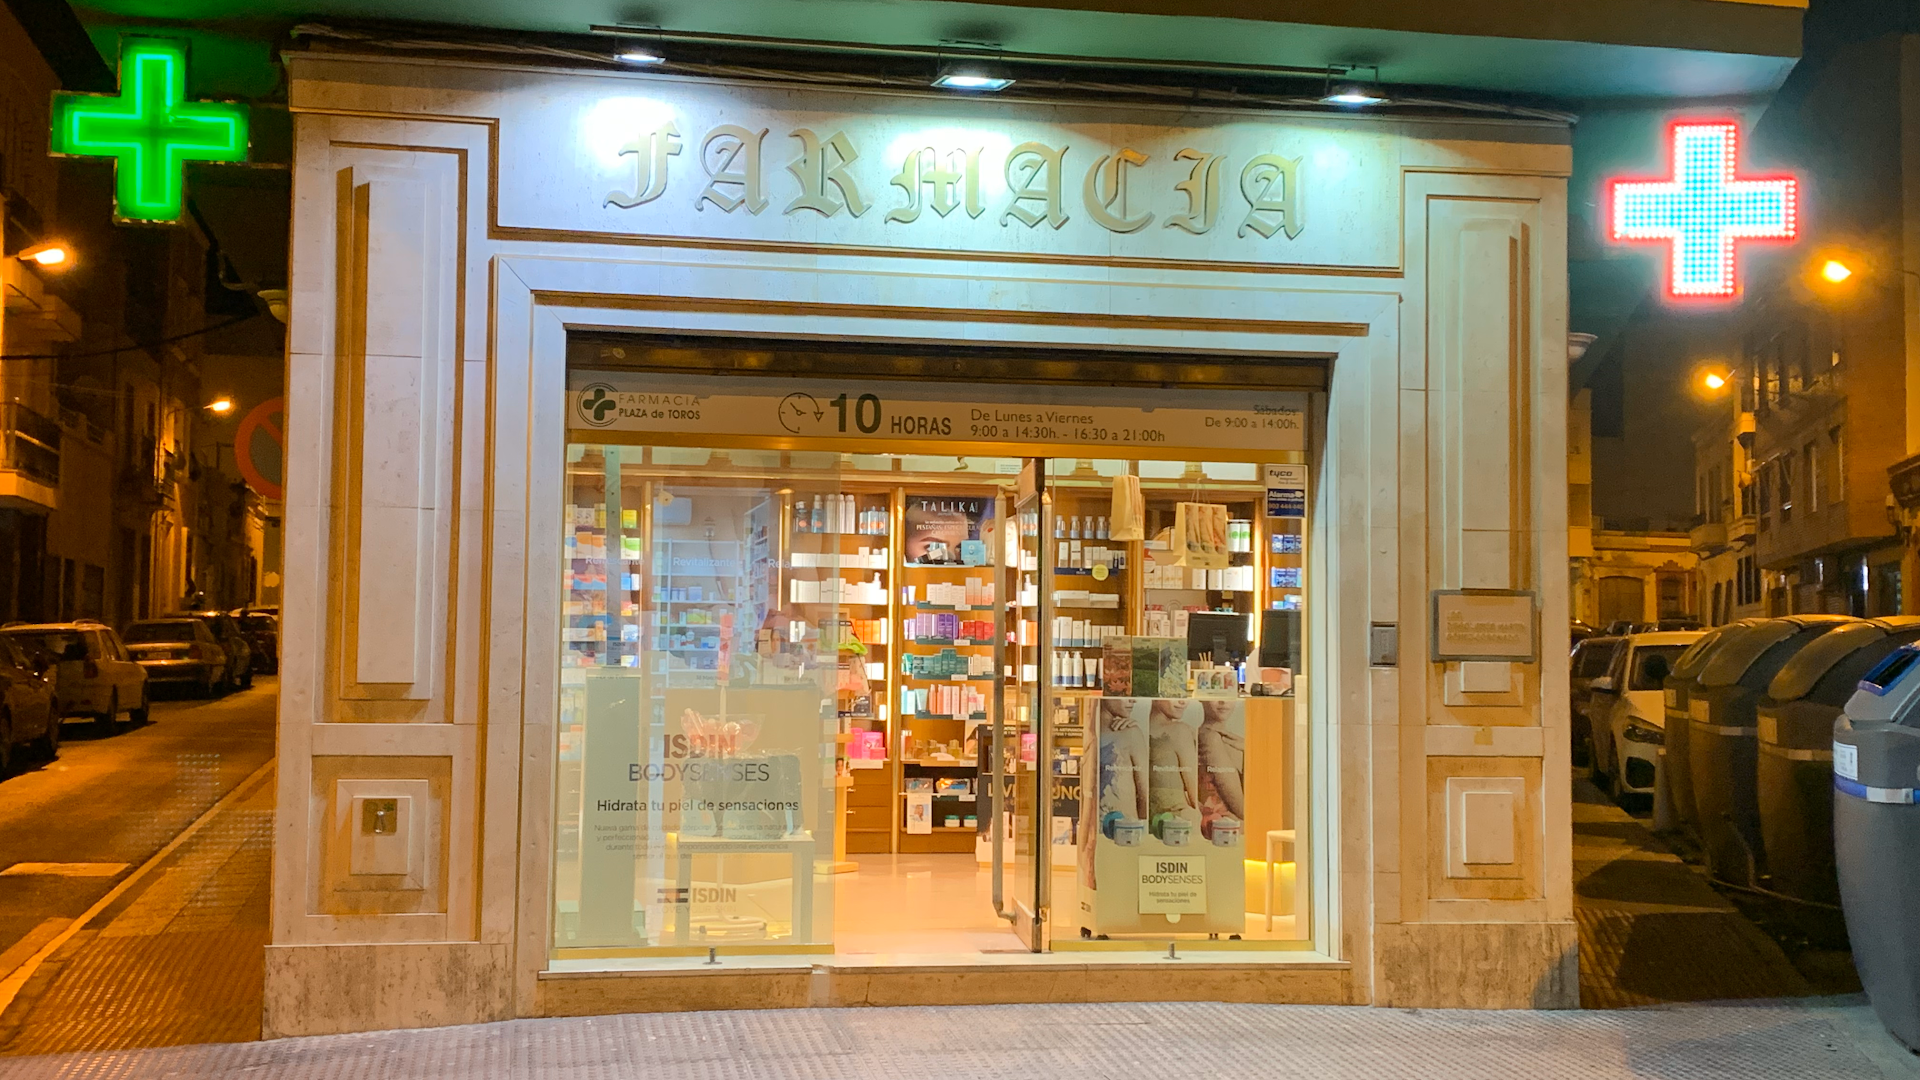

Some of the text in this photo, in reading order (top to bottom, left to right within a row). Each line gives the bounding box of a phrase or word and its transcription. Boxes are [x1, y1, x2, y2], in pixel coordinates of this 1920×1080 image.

[603, 124, 1305, 241] FARMACIA
[618, 393, 700, 406] FARMACIA
[618, 408, 701, 420] PLAZA de TOROS
[829, 393, 952, 435] 10 HORAS
[971, 408, 1094, 425] De Lunes a Viernes
[1204, 416, 1300, 429] De 9:00 a 14:00h.
[970, 424, 998, 438] 9:00
[1002, 428, 1009, 438] a
[1074, 427, 1108, 440] 16:30
[1111, 431, 1118, 440] a
[1122, 429, 1165, 442] 21:00h
[1269, 470, 1293, 478] tyco
[921, 501, 976, 513] TALIKA
[673, 556, 736, 567] Revitalizante
[663, 734, 736, 759] ISDIN
[629, 763, 770, 782] BODYSENSES
[596, 799, 800, 814] Hidrata tu piel de sensaciones
[1156, 862, 1188, 874] ISDIN
[1142, 874, 1203, 885] BODYSENSES
[692, 887, 736, 903] ISDIN
